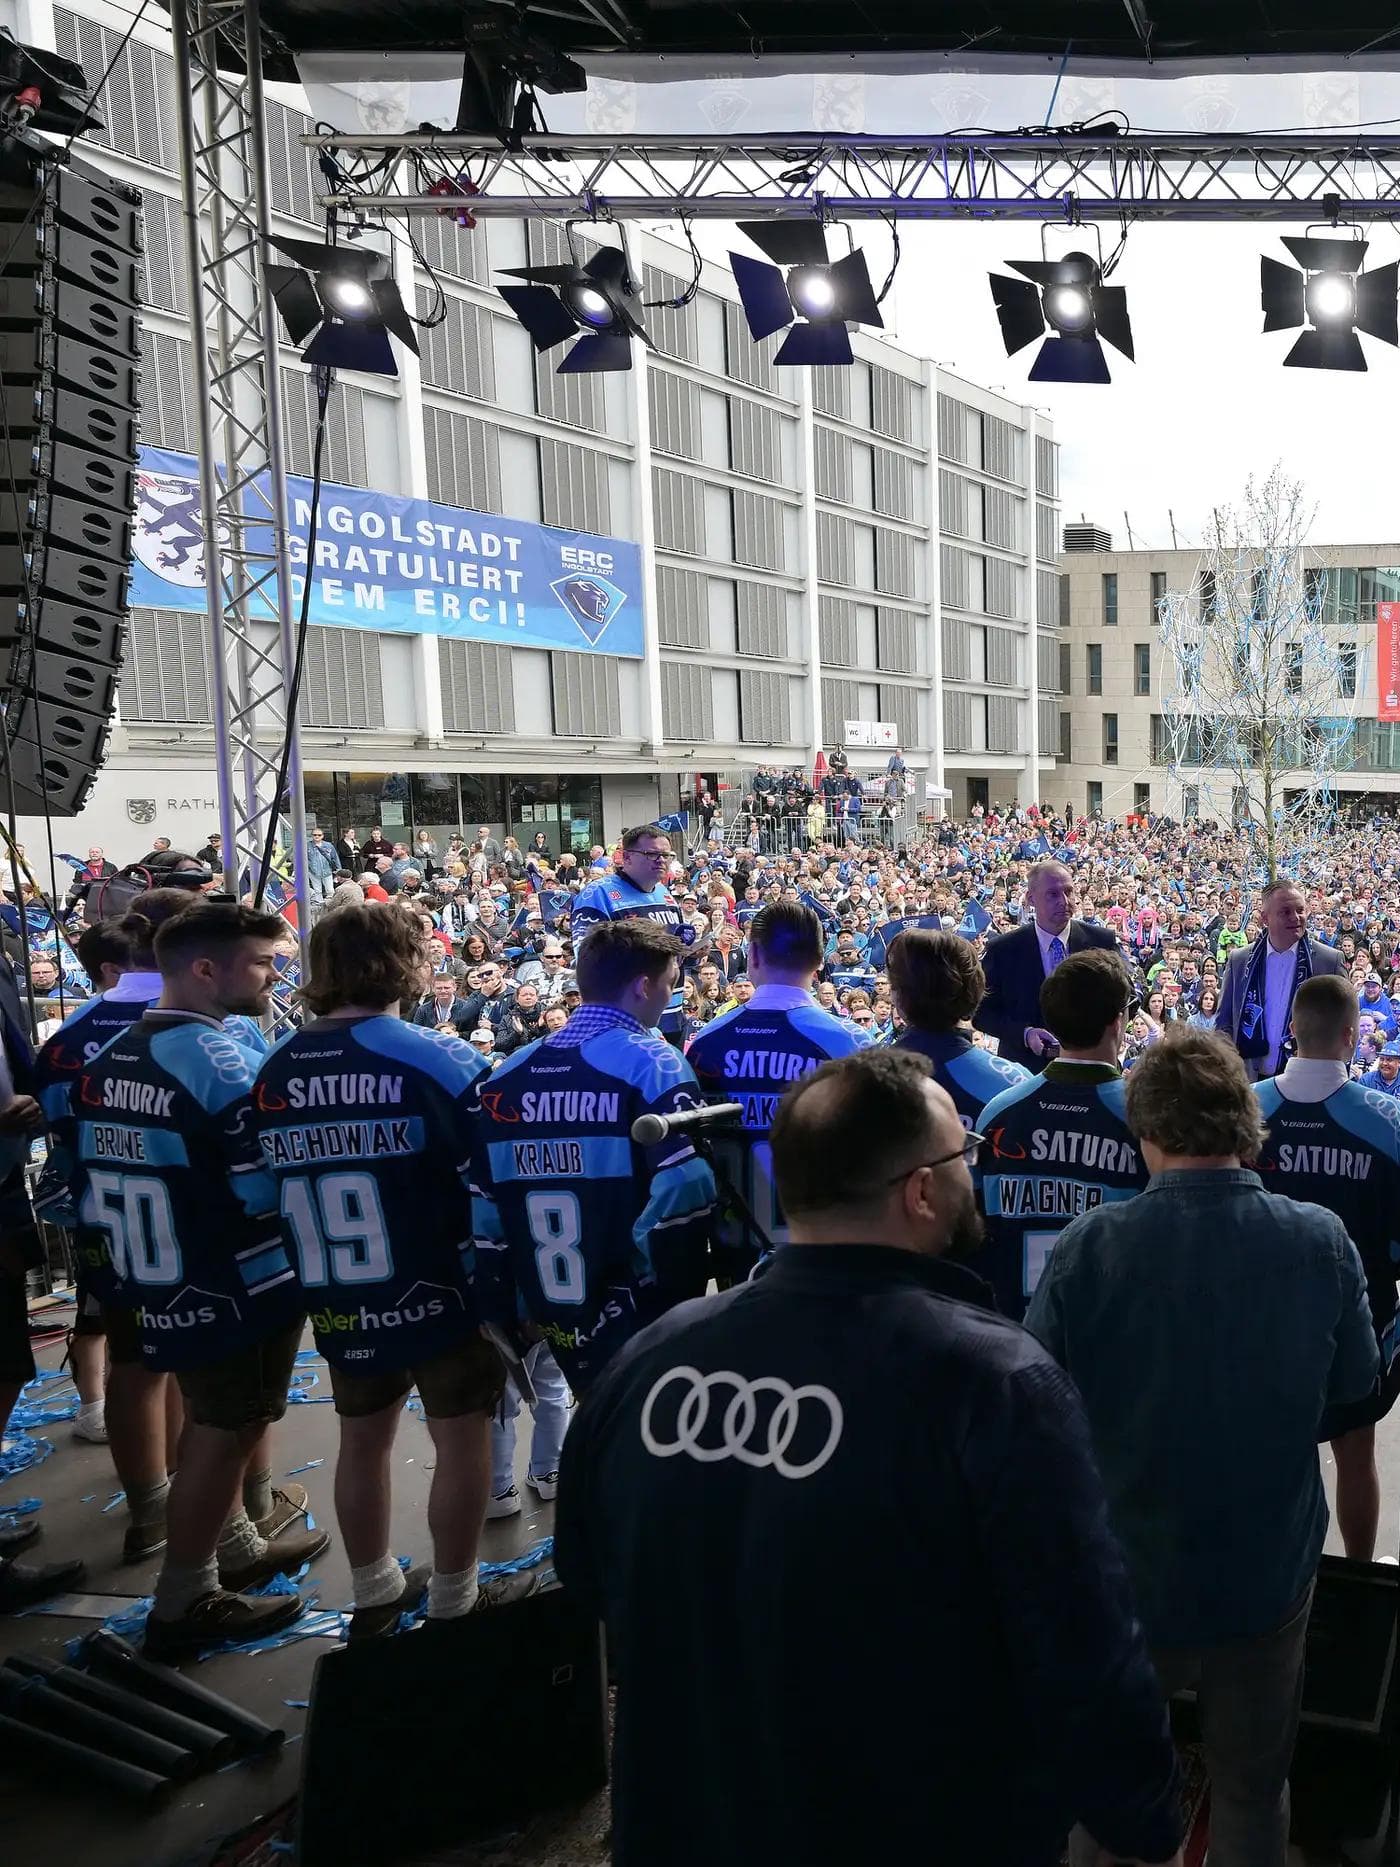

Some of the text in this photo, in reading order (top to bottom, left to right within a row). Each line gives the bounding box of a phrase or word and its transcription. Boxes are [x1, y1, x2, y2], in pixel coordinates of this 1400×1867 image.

[294, 498, 522, 562] NGOLSTADT
[288, 535, 524, 594] GRATULIERT
[561, 545, 613, 570] ERC
[414, 588, 526, 628] ERCI!
[103, 1077, 176, 1118] SATURN
[287, 1074, 404, 1109] SATURN
[522, 1091, 620, 1123] SATURN
[92, 1123, 148, 1162] BRUNE
[1031, 1128, 1138, 1175] SATURN
[1279, 1143, 1372, 1180] SATURN
[1000, 1176, 1105, 1219] WAGNER
[280, 1171, 395, 1288] 19
[525, 1189, 586, 1305] 8
